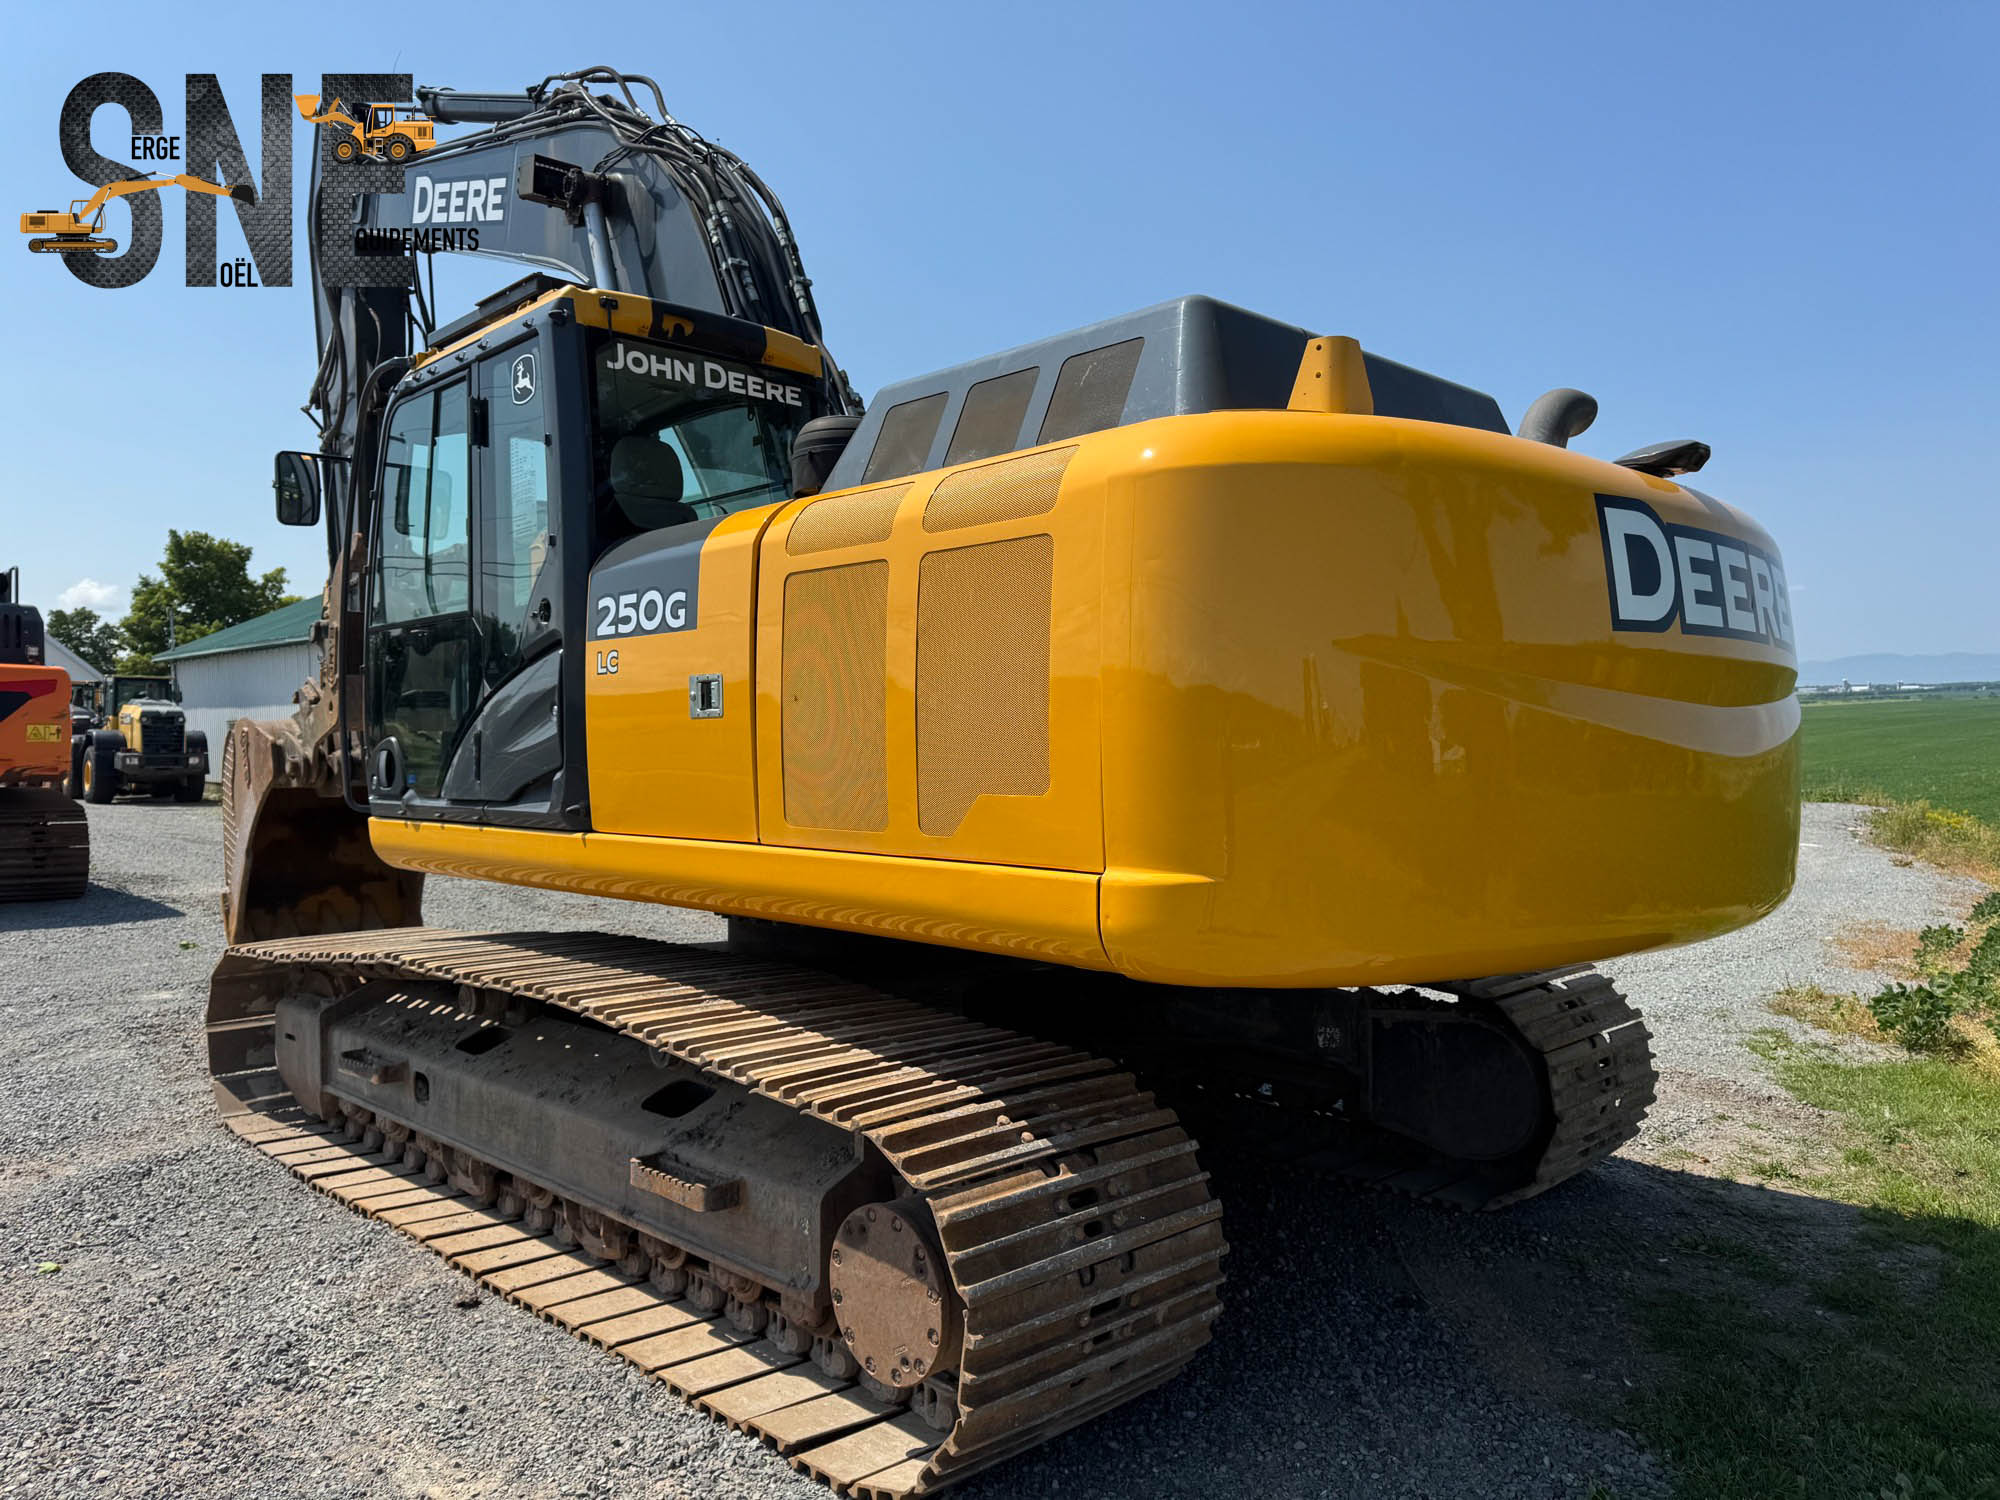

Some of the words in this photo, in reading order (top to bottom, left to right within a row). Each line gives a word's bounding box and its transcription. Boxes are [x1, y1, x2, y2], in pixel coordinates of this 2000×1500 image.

[412, 175, 507, 224] DEERE
[606, 343, 696, 385] JOHN
[703, 361, 803, 407] DEERE
[596, 589, 687, 637] 250G
[596, 649, 619, 676] LC
